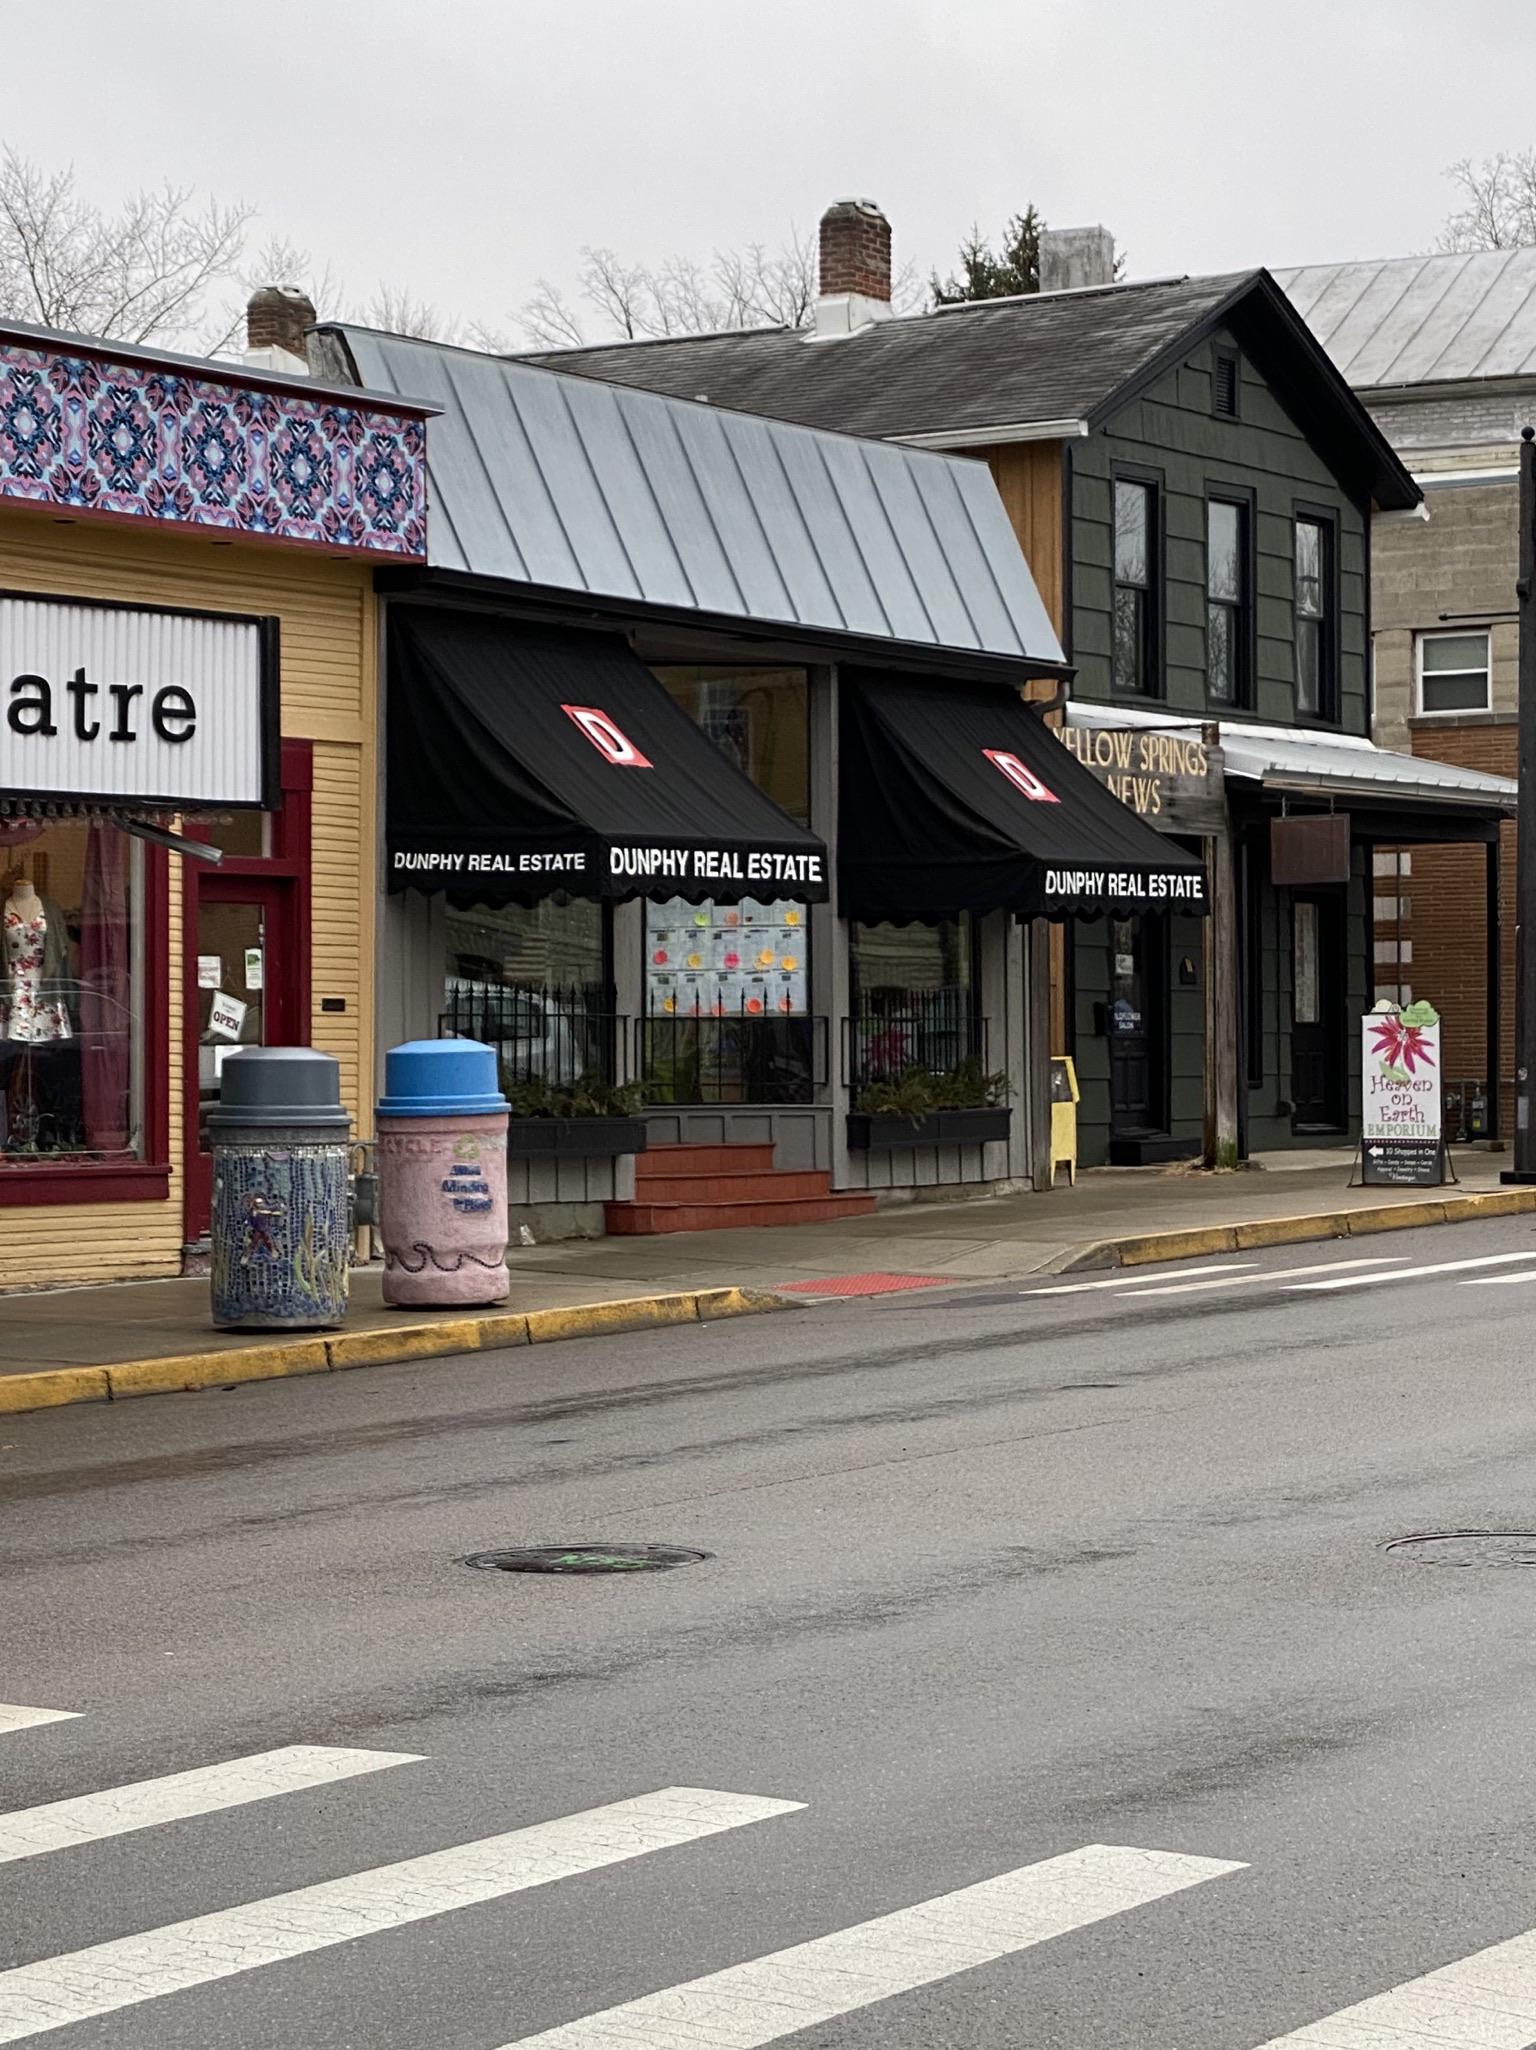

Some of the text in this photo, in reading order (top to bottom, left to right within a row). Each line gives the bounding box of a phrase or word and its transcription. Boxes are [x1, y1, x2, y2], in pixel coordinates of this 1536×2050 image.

[7, 667, 196, 743] atre
[573, 710, 636, 761] D
[1140, 735, 1207, 776] SPRINGS
[993, 753, 1047, 798] D
[1107, 774, 1160, 814] NEWS
[394, 851, 586, 872] DUNPHY REAL ESTATE
[610, 846, 823, 882] DUNPHY REAL ESTATE
[1045, 870, 1203, 899] DUNPHY REAL ESTATE
[213, 1011, 240, 1031] OPEN
[1370, 1073, 1433, 1094] Heaven
[1379, 1104, 1425, 1123] Earth
[1391, 1094, 1413, 1106] on
[1367, 1123, 1437, 1137] EMPORIUM
